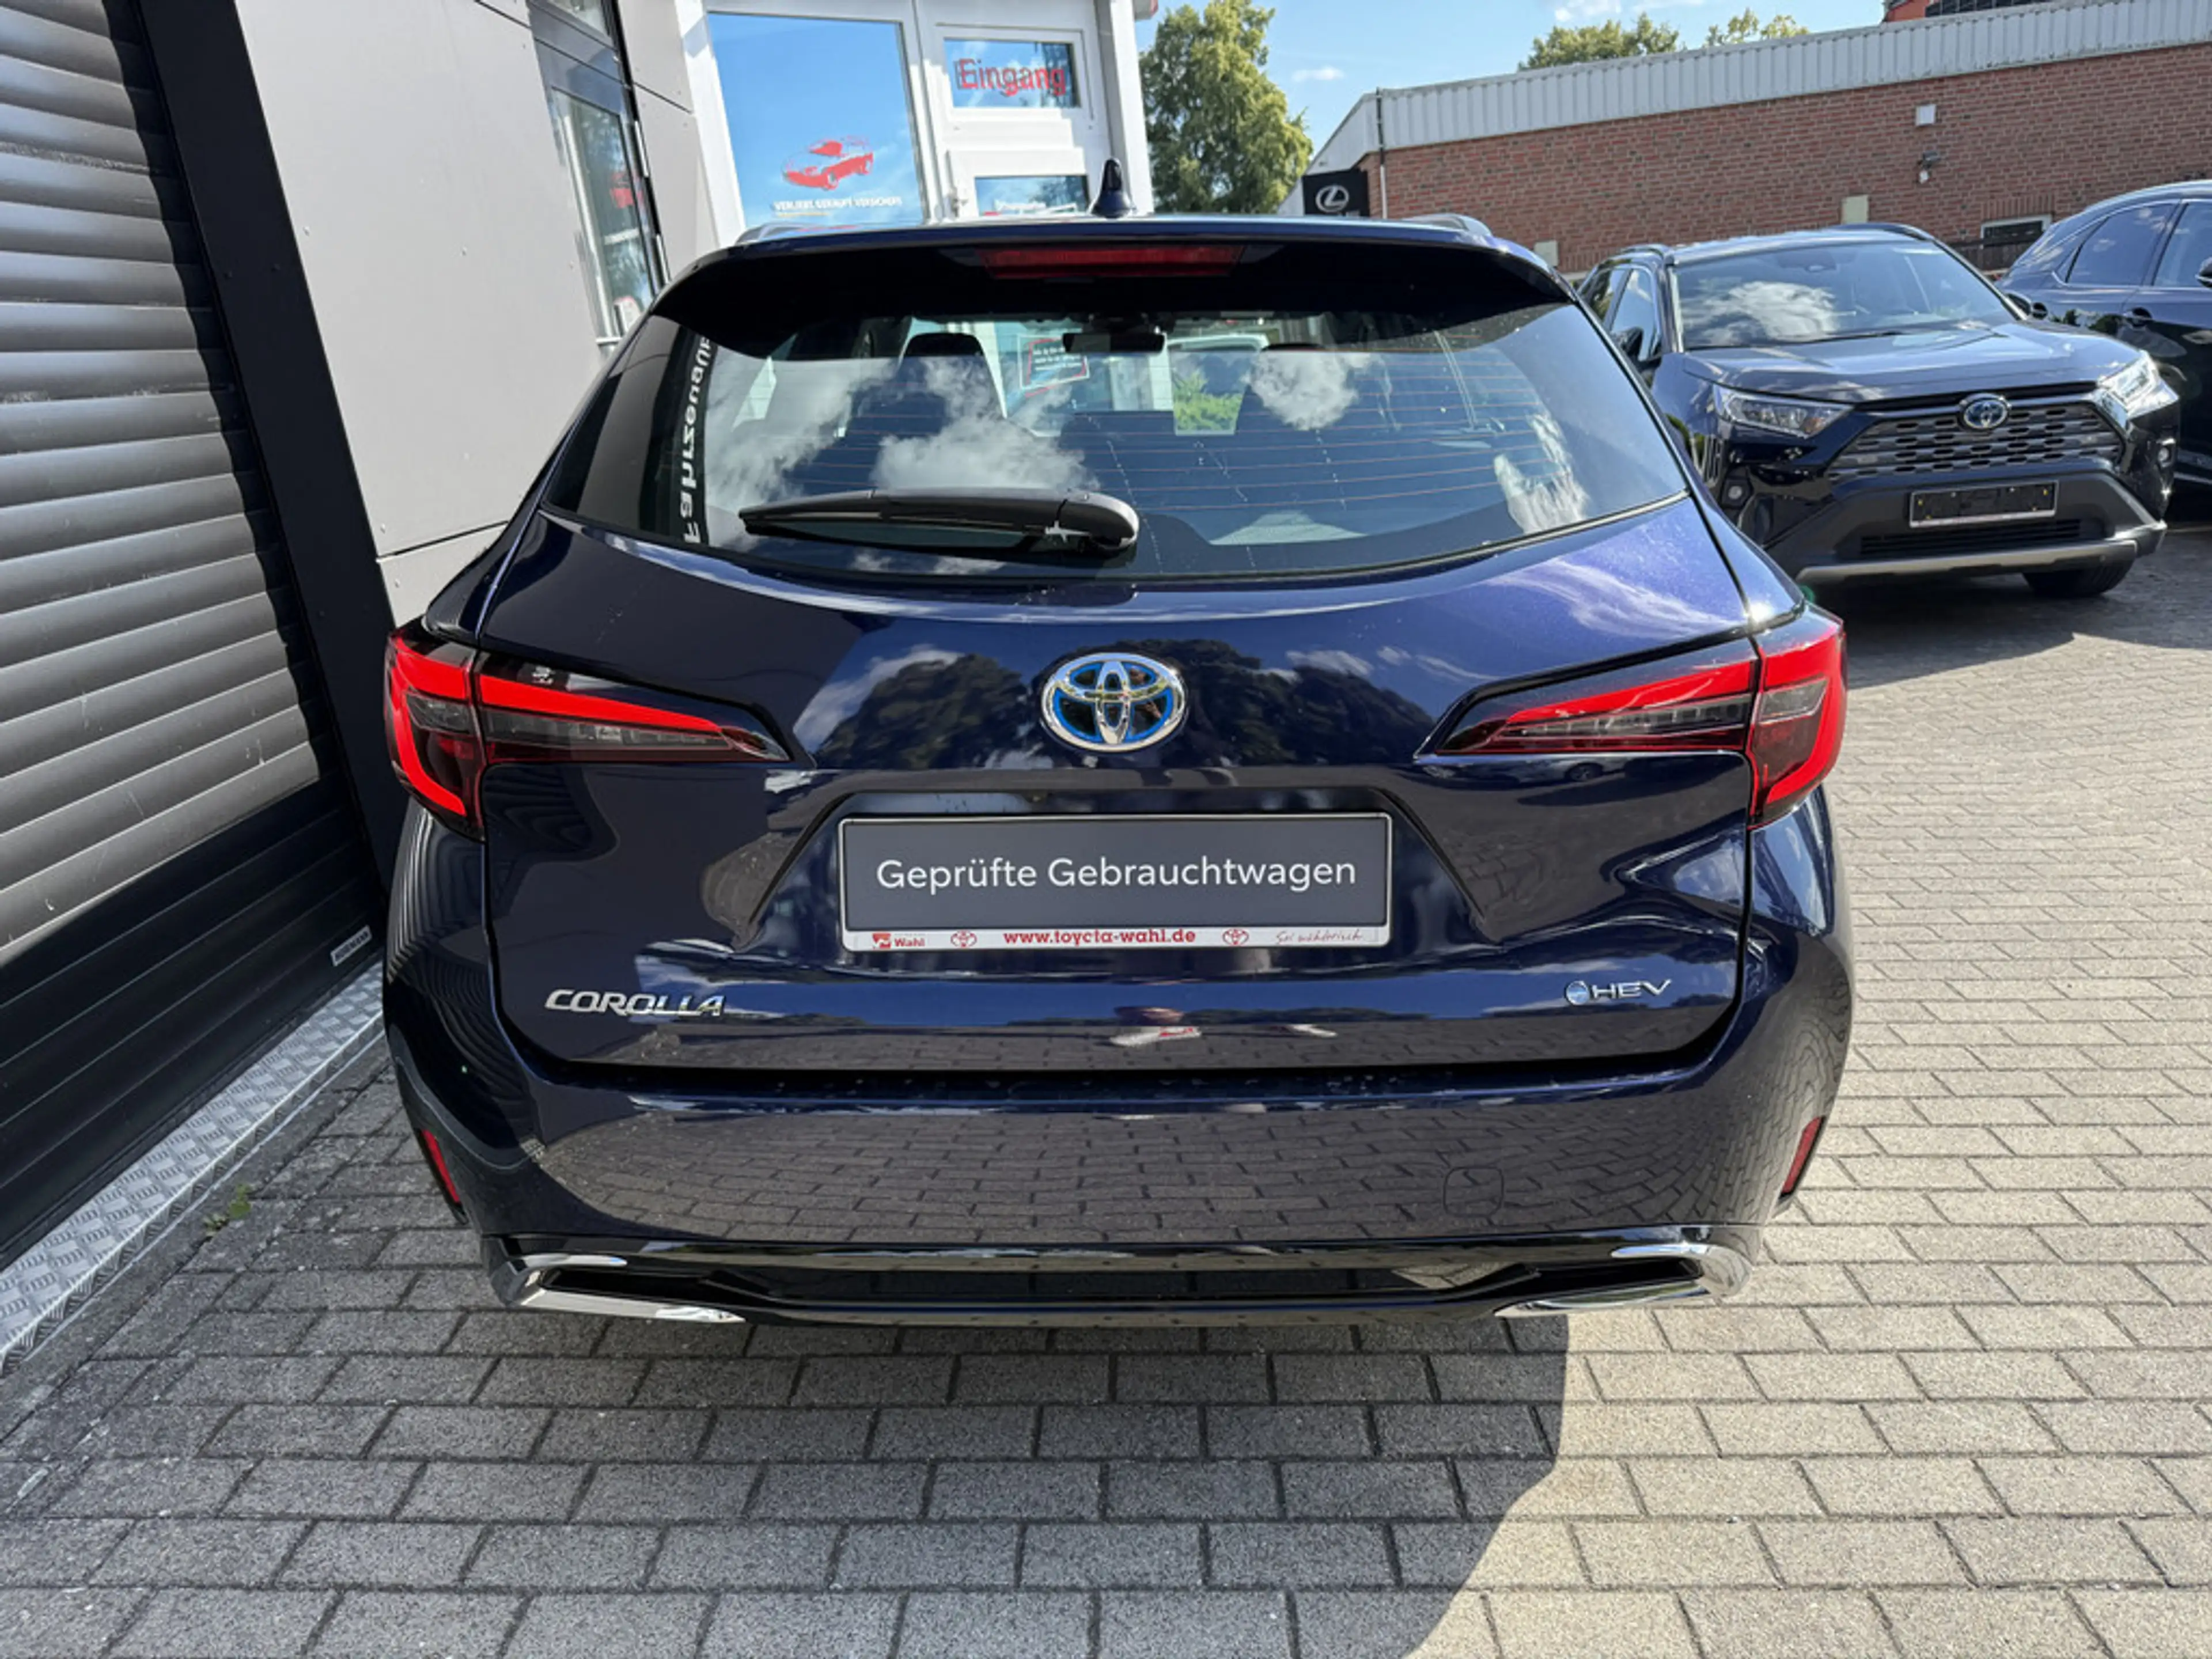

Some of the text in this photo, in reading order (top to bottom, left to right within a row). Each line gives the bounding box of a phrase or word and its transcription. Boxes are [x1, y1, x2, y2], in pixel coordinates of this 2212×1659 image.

[959, 58, 1066, 97] Eingang
[876, 855, 1356, 896] Geprüfte Gebrauchtwagen
[894, 937, 926, 947] Wahl
[544, 988, 725, 1017] COROLLA
[1592, 978, 1672, 999] HEV
